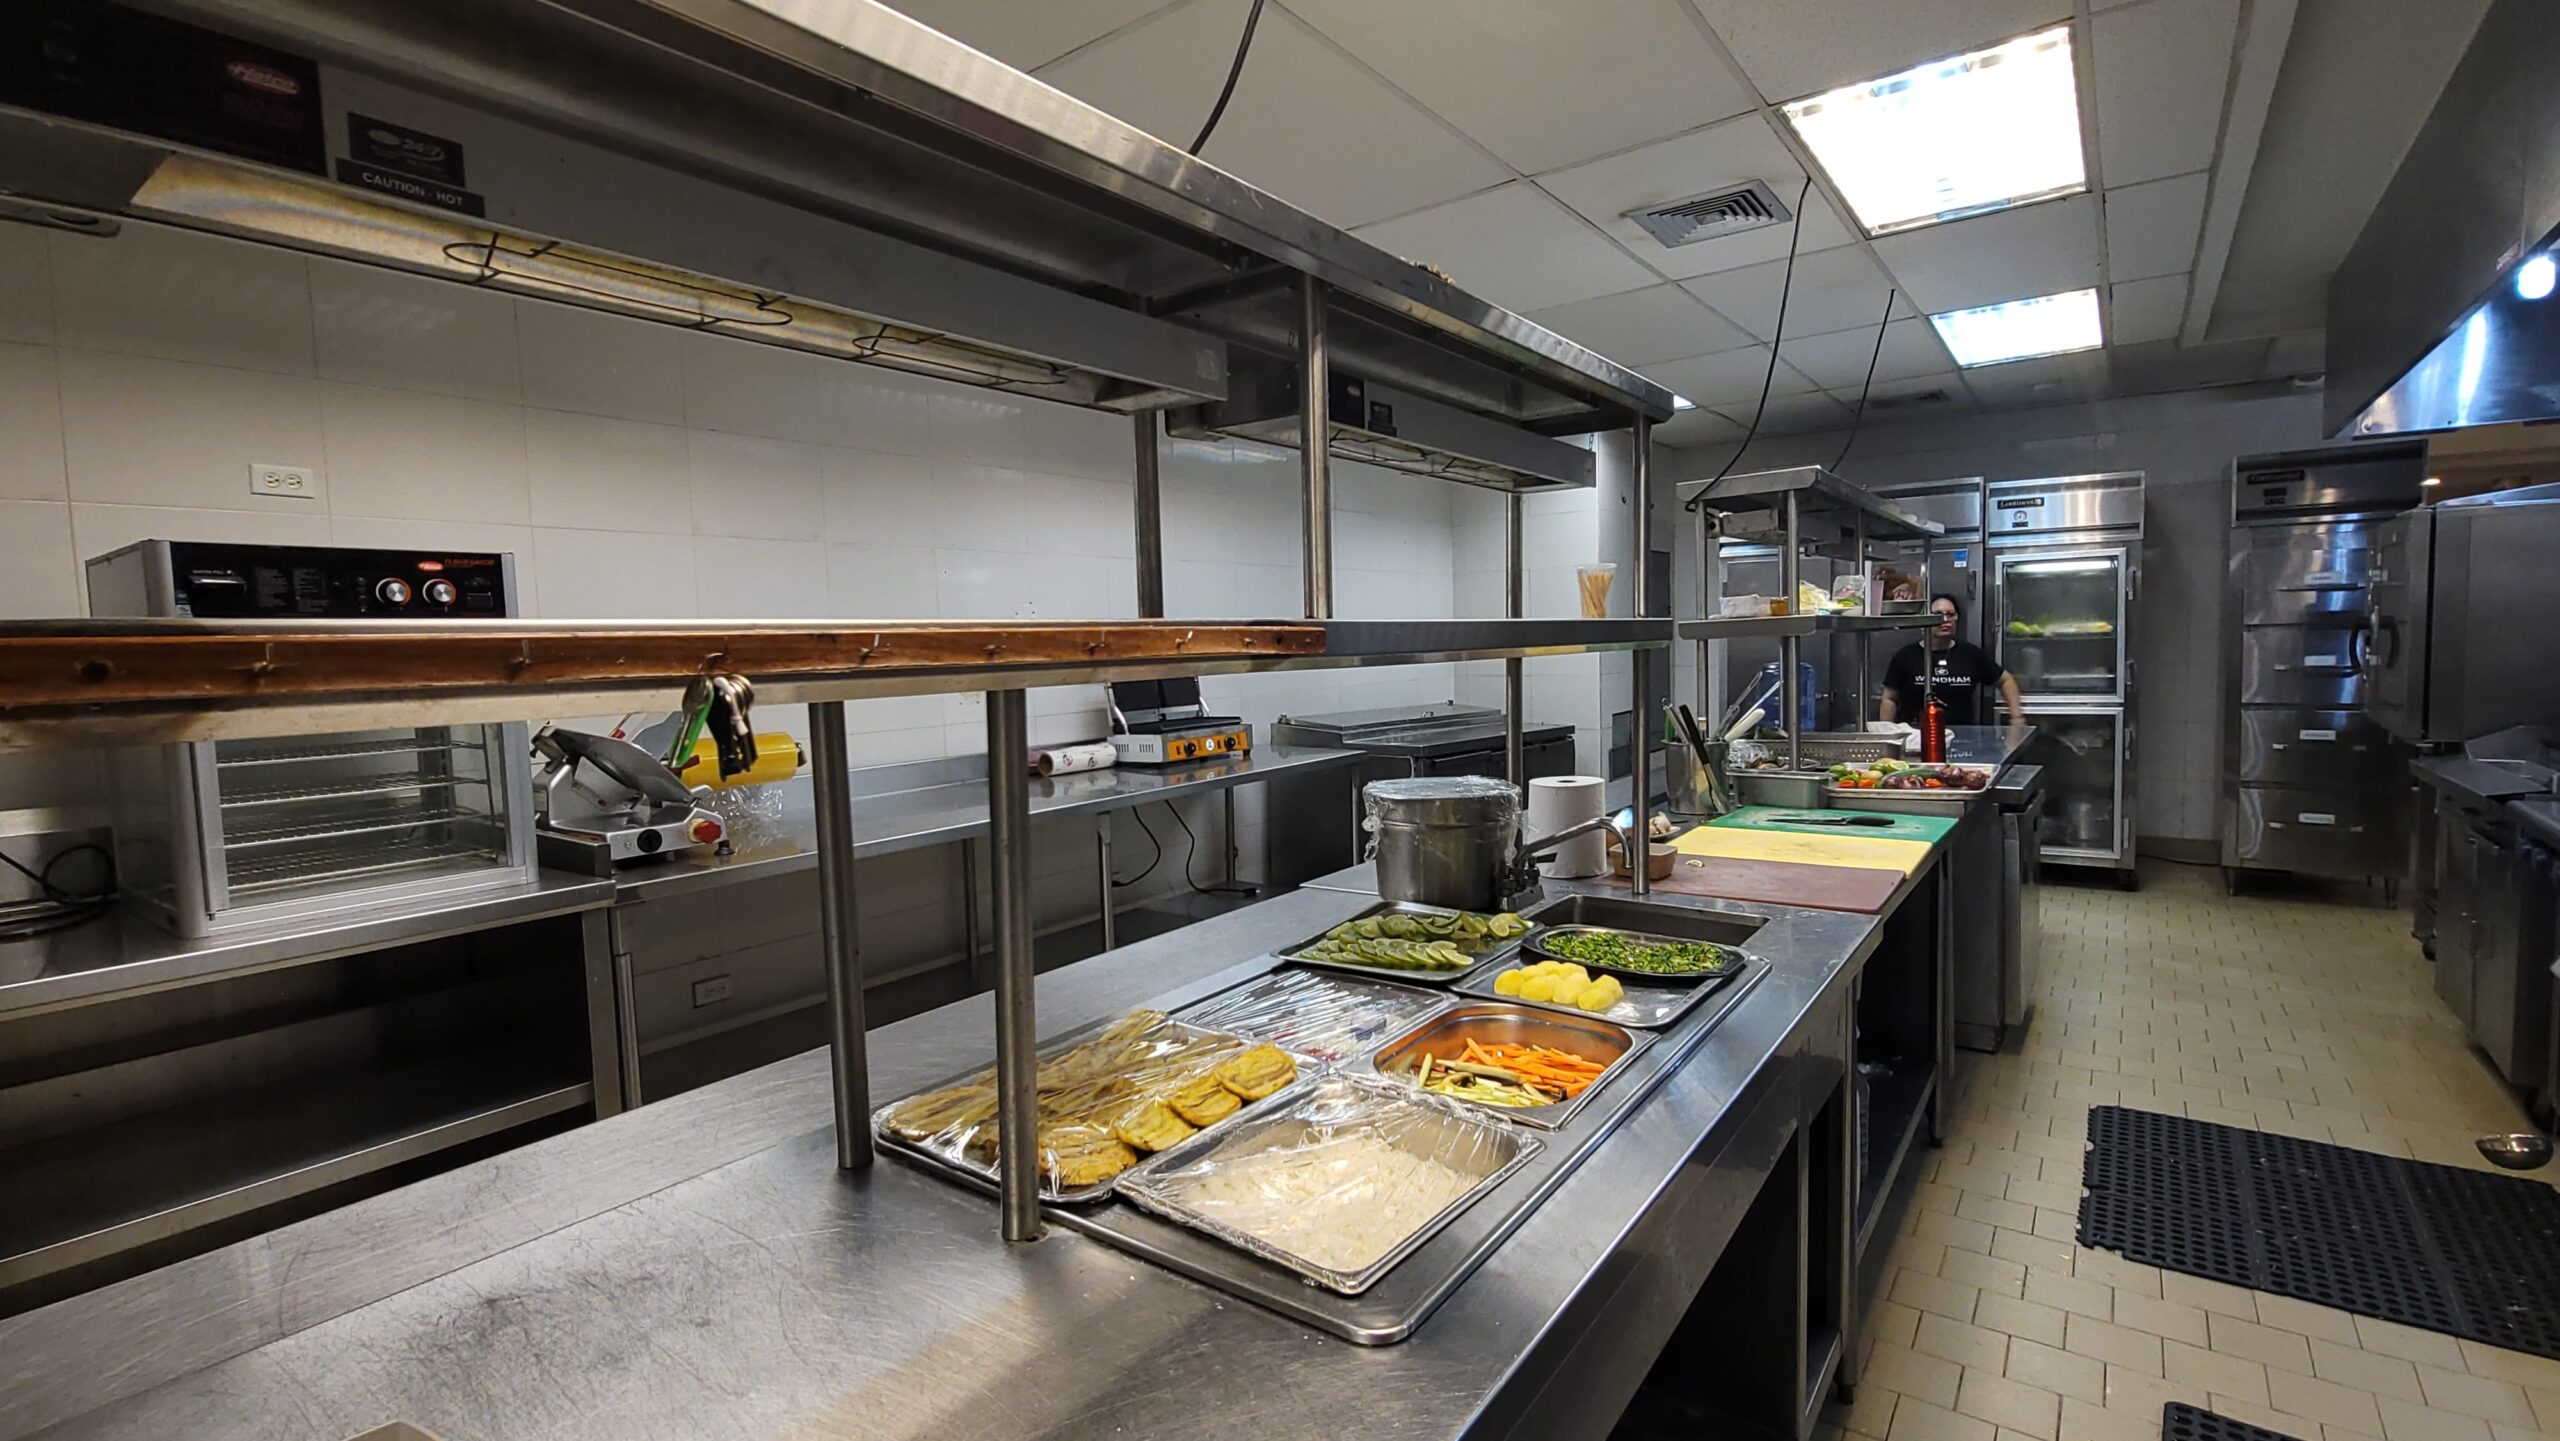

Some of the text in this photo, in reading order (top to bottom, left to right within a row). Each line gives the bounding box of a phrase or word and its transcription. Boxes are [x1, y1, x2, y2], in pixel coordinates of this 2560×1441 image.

[361, 171, 426, 198] CAUTION
[436, 189, 464, 207] HOT
[1914, 675, 1971, 683] WNDHAM
